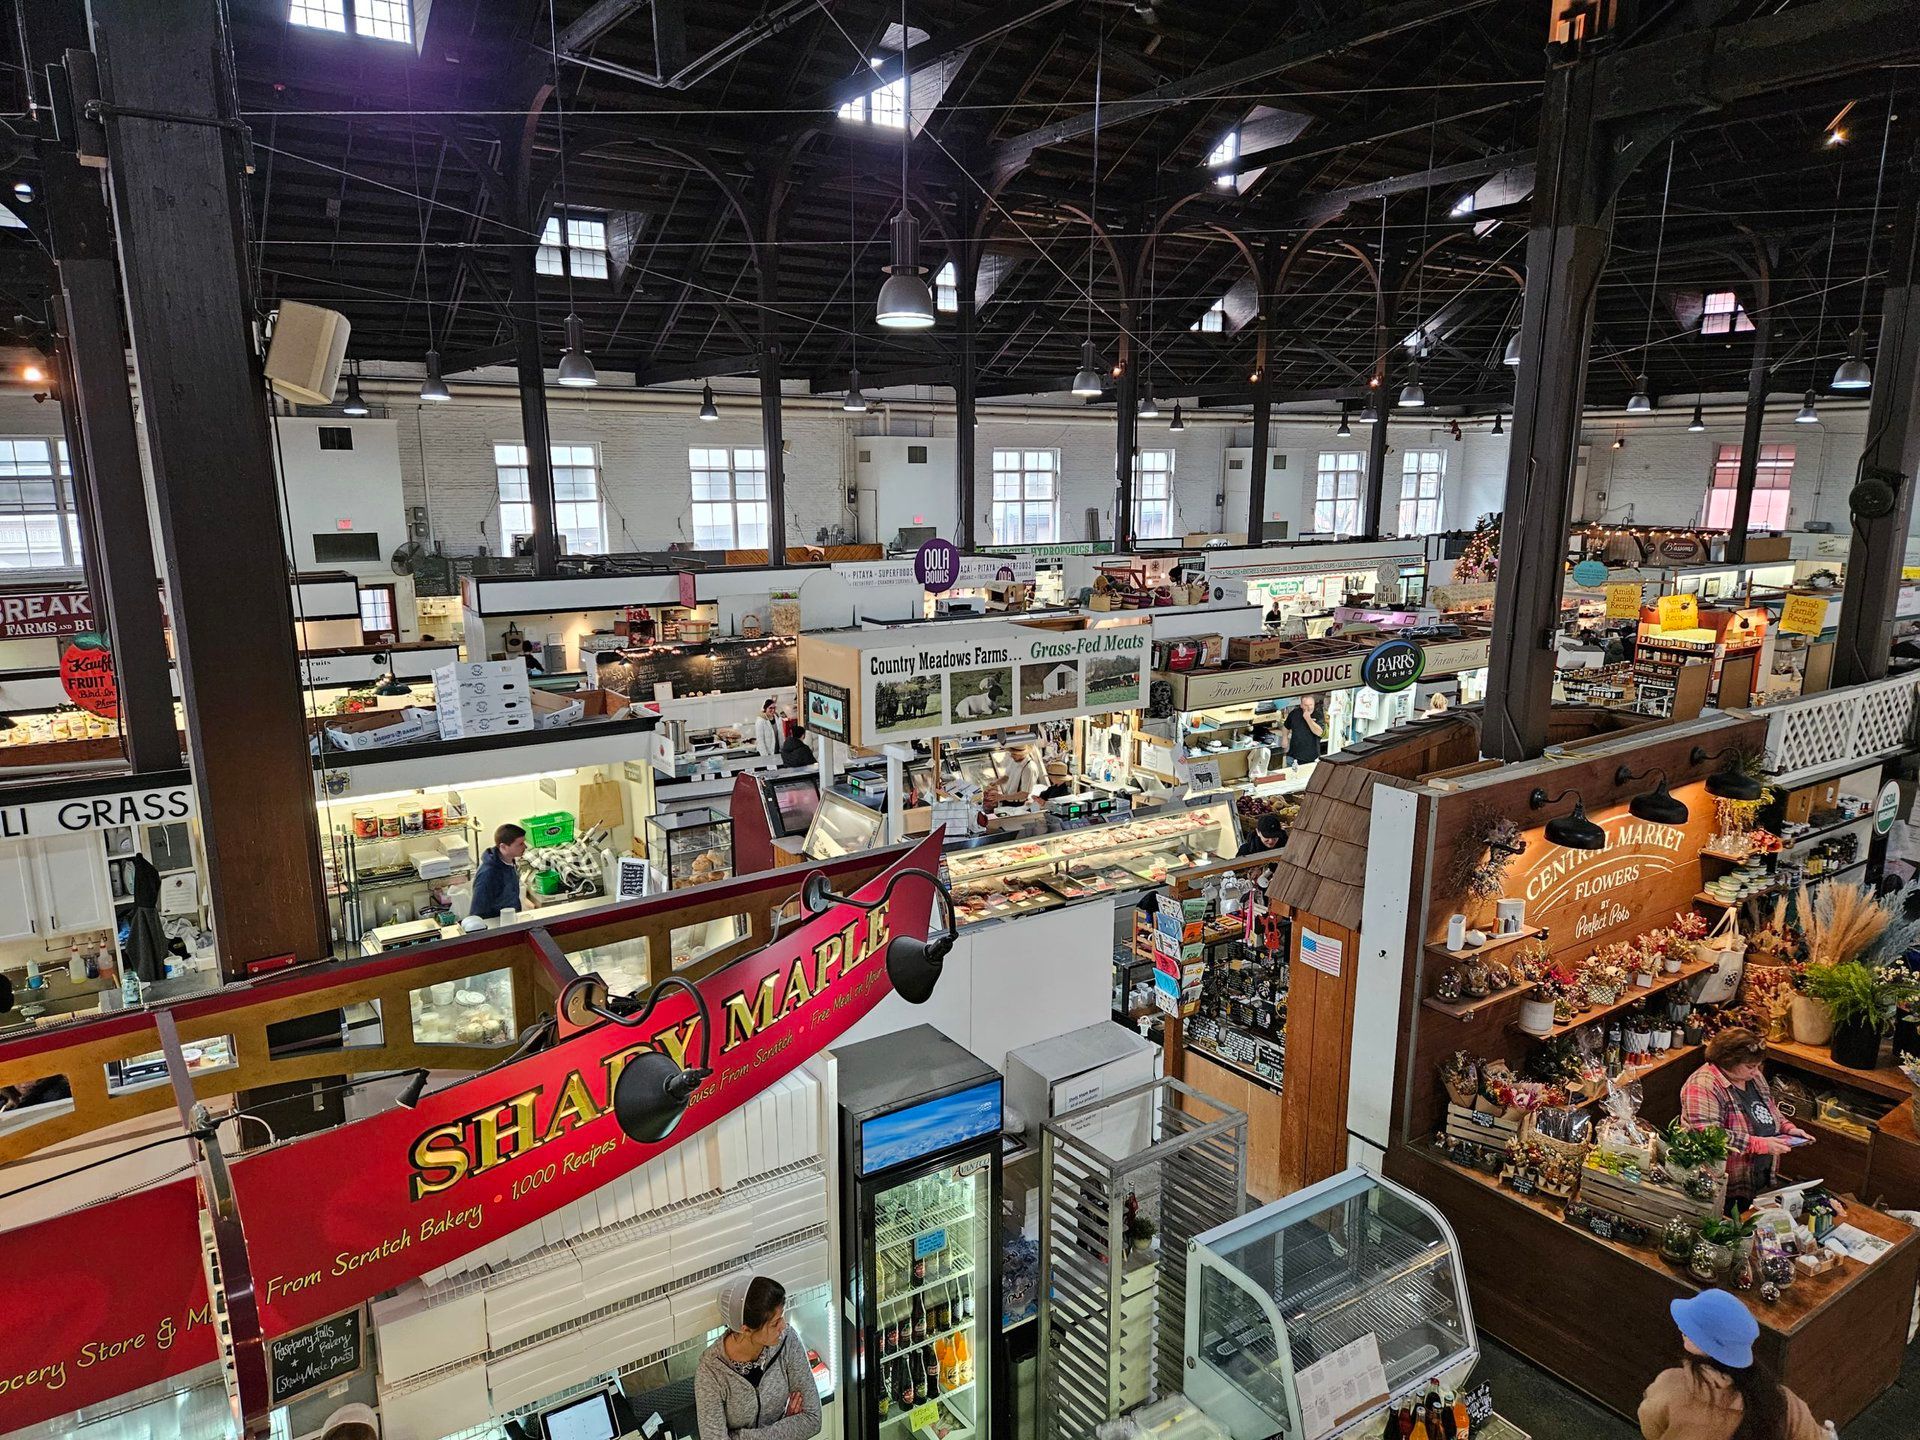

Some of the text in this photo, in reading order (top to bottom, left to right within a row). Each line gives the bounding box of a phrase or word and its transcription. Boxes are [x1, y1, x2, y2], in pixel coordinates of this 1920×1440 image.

[924, 548, 950, 570] OOLA
[1030, 545, 1090, 557] HYDROPONICS
[853, 570, 873, 579] PITAYA
[879, 567, 914, 578] SUPERFOODS
[925, 570, 949, 584] BOWLS
[978, 563, 995, 573] PITAYA
[1378, 592, 1397, 602] BREAD
[1610, 602, 1636, 611] Recipes
[1793, 598, 1819, 609] Amish
[0, 595, 91, 624] REAK
[1665, 614, 1693, 622] Recipes
[1788, 613, 1817, 625] Recipes
[1790, 606, 1817, 617] Family
[5, 621, 57, 636] FARMS
[1030, 634, 1145, 659] Grass-Fed Meats
[870, 656, 915, 677] Country
[919, 650, 971, 671] Meadows
[1376, 648, 1415, 673] BARR'S
[67, 676, 105, 690] FRUIT
[1210, 681, 1241, 698] Farm
[1243, 677, 1274, 693] Fresh
[1282, 664, 1352, 688] PRODUCE
[1428, 652, 1454, 667] Farm
[1454, 648, 1480, 662] Fresh
[0, 790, 189, 838] LI GRASS
[1617, 823, 1685, 852] MARKET
[1574, 864, 1640, 900] FLOWERS
[1601, 899, 1610, 910] BY
[1575, 902, 1630, 939] Perfect Pots
[719, 900, 890, 1054] MAPLE
[266, 1269, 321, 1304] From
[331, 1228, 411, 1276] Scratch
[420, 1204, 483, 1241] Bakery
[512, 1163, 556, 1200] 1,000
[562, 1138, 616, 1175] Recipes
[686, 1083, 716, 1110] ouse
[720, 1063, 749, 1091] From
[753, 1029, 793, 1067] Scratch
[811, 1008, 830, 1030] Free
[833, 989, 853, 1009] Meal
[865, 972, 883, 997] Your
[77, 1333, 146, 1368] Store
[157, 1316, 176, 1349] &
[273, 1335, 315, 1361] Raspberry
[319, 1334, 352, 1358] Bakery
